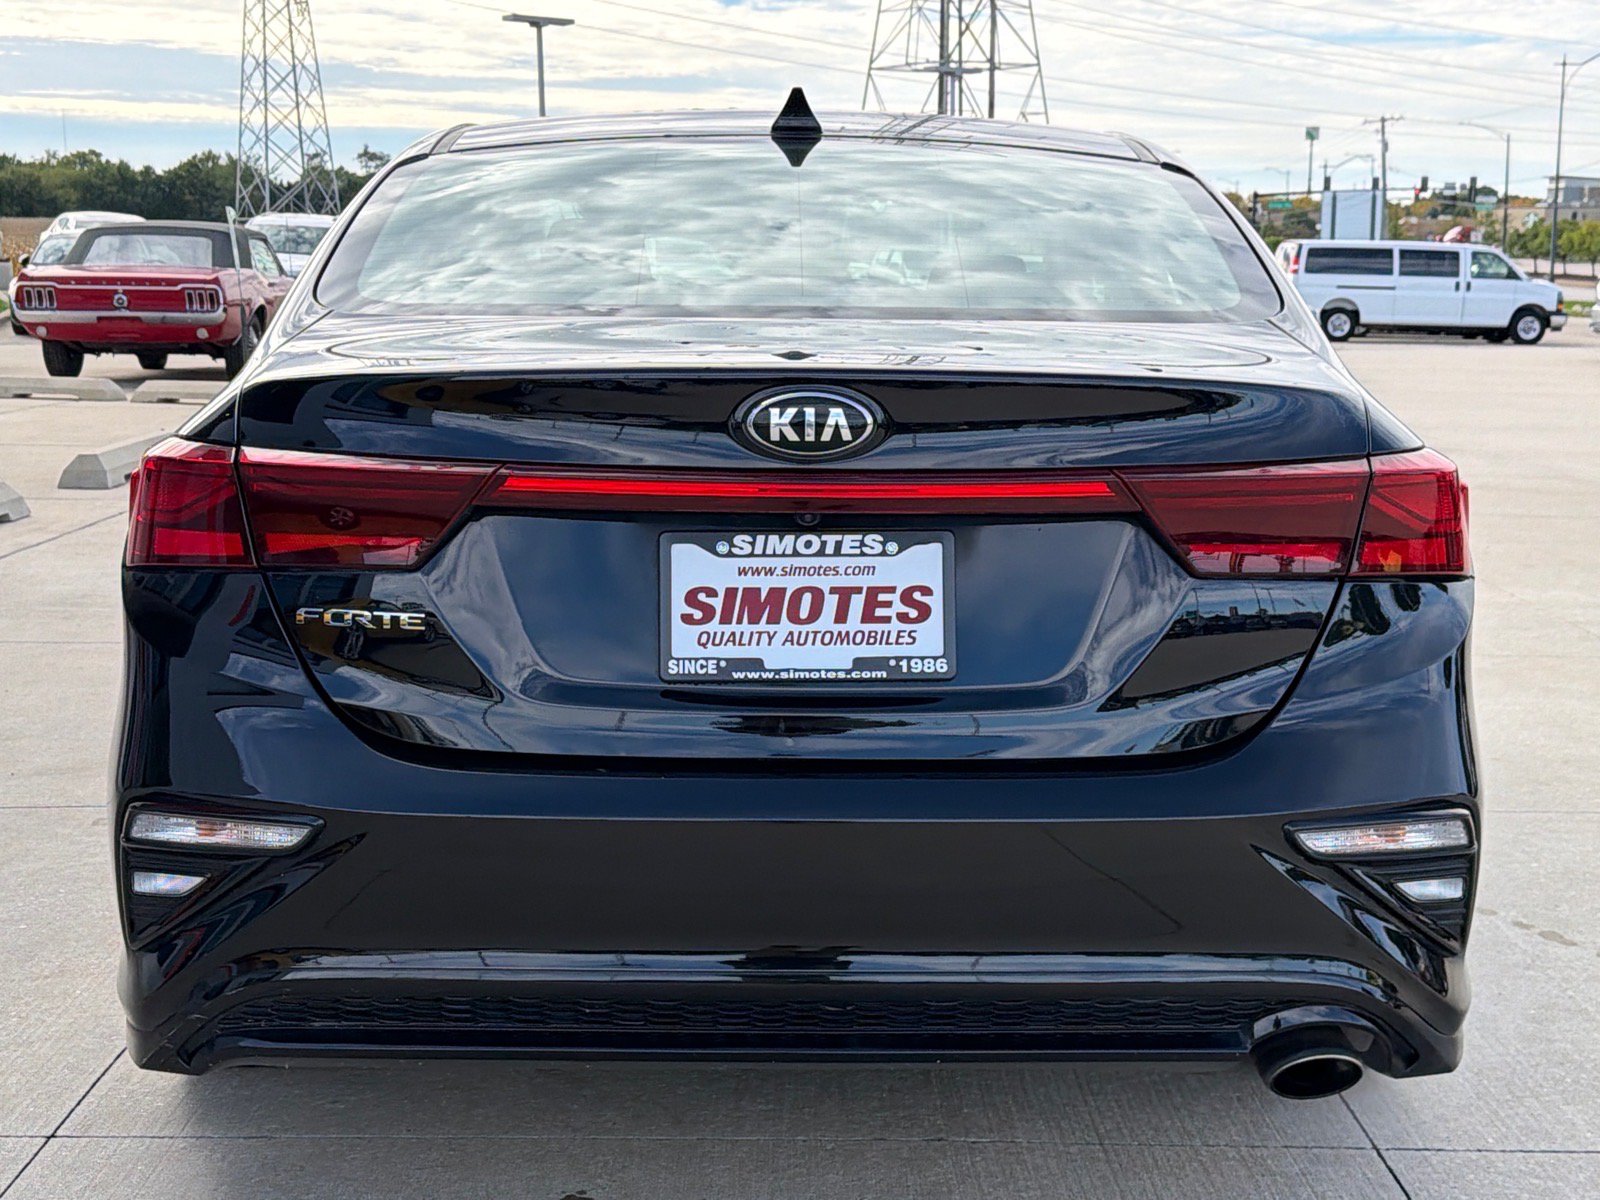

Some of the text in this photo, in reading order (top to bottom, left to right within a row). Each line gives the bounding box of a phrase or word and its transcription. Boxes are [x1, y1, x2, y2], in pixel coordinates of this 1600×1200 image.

[769, 407, 853, 442] KIA
[731, 534, 884, 555] SIMOTES
[737, 564, 876, 577] www.simotes.com
[680, 585, 934, 626] SIMOTES
[295, 607, 426, 631] FORTE
[697, 629, 917, 649] QUALITY AUTOMOBILES
[667, 659, 718, 675] SINCE
[732, 668, 888, 680] www.simotes.com
[898, 658, 949, 674] 1986
